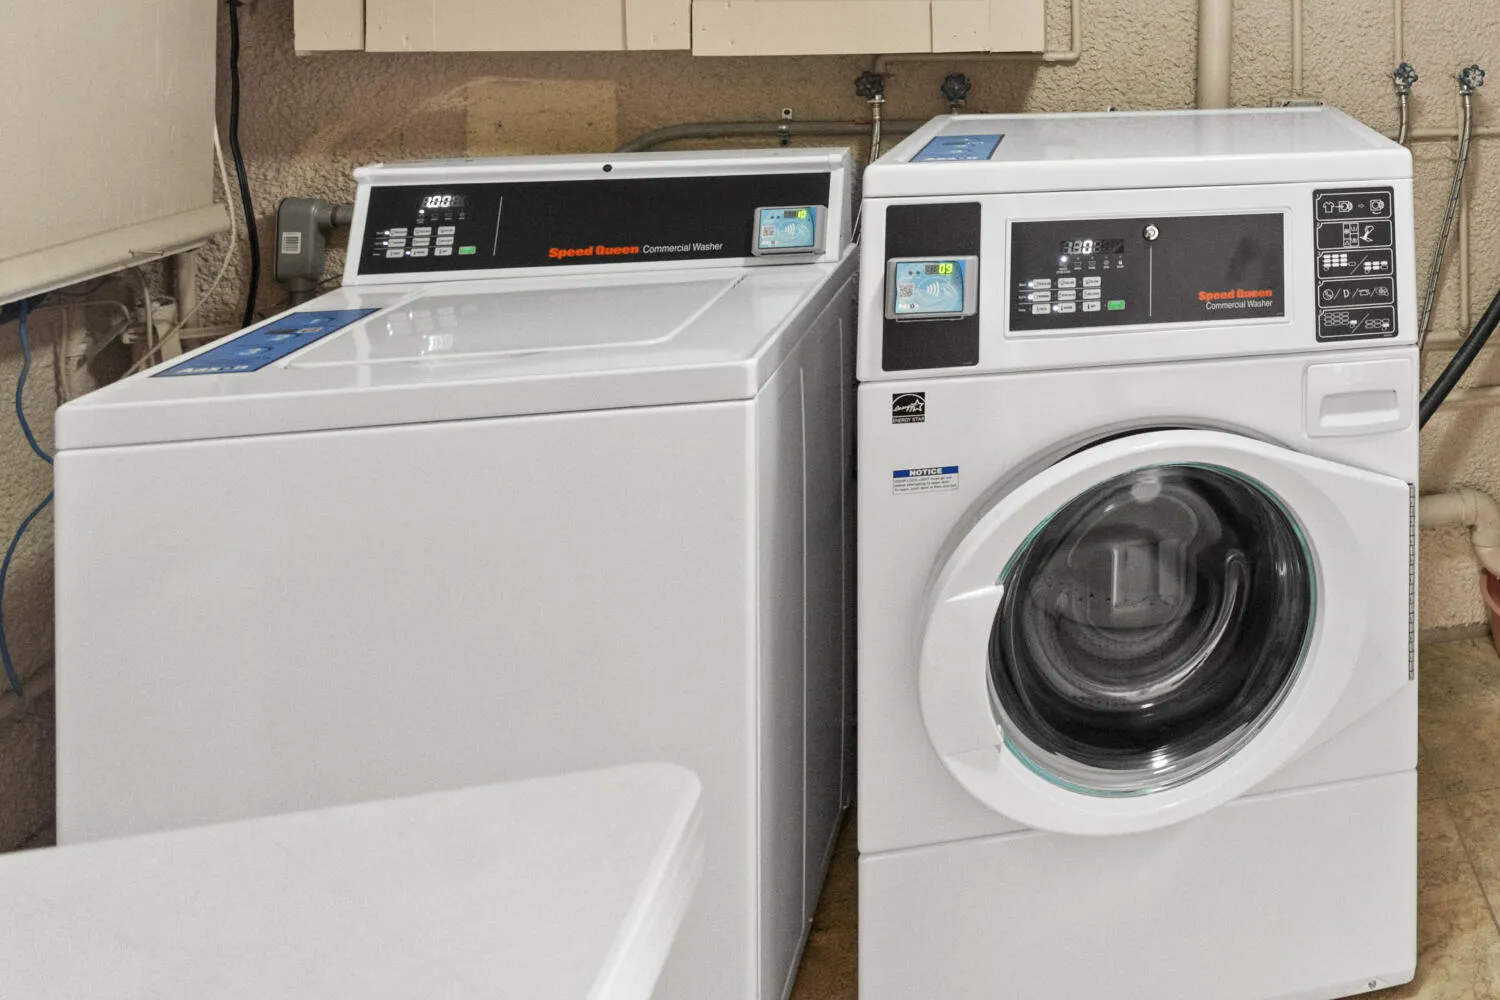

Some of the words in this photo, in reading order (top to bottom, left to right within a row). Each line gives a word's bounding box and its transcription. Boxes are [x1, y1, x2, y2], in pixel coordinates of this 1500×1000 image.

[549, 245, 594, 259] Speed
[596, 245, 640, 256] Queen
[642, 243, 691, 254] Commercial
[692, 242, 723, 251] Washer
[939, 264, 953, 274] 09
[1198, 289, 1235, 301] Speed
[1236, 288, 1272, 298] Queen
[1206, 301, 1246, 310] Commercial
[1247, 300, 1272, 308] Washer
[909, 468, 942, 476] NOTICE
